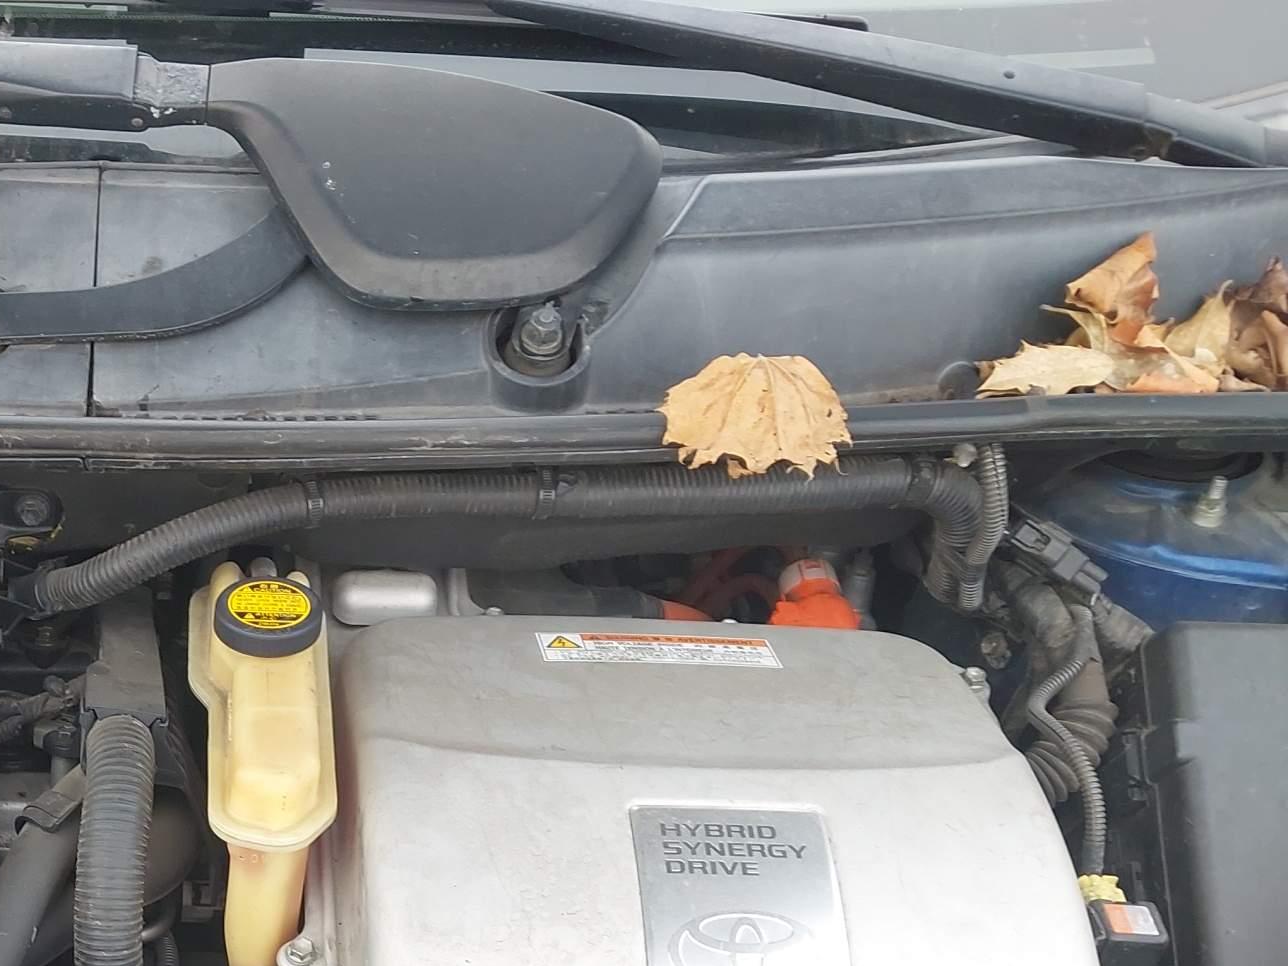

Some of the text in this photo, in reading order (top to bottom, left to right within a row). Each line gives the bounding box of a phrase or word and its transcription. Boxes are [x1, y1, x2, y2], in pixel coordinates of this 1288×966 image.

[660, 823, 776, 839] HYBRID
[663, 841, 807, 858] SYNERGY
[664, 860, 760, 876] DRIVE
